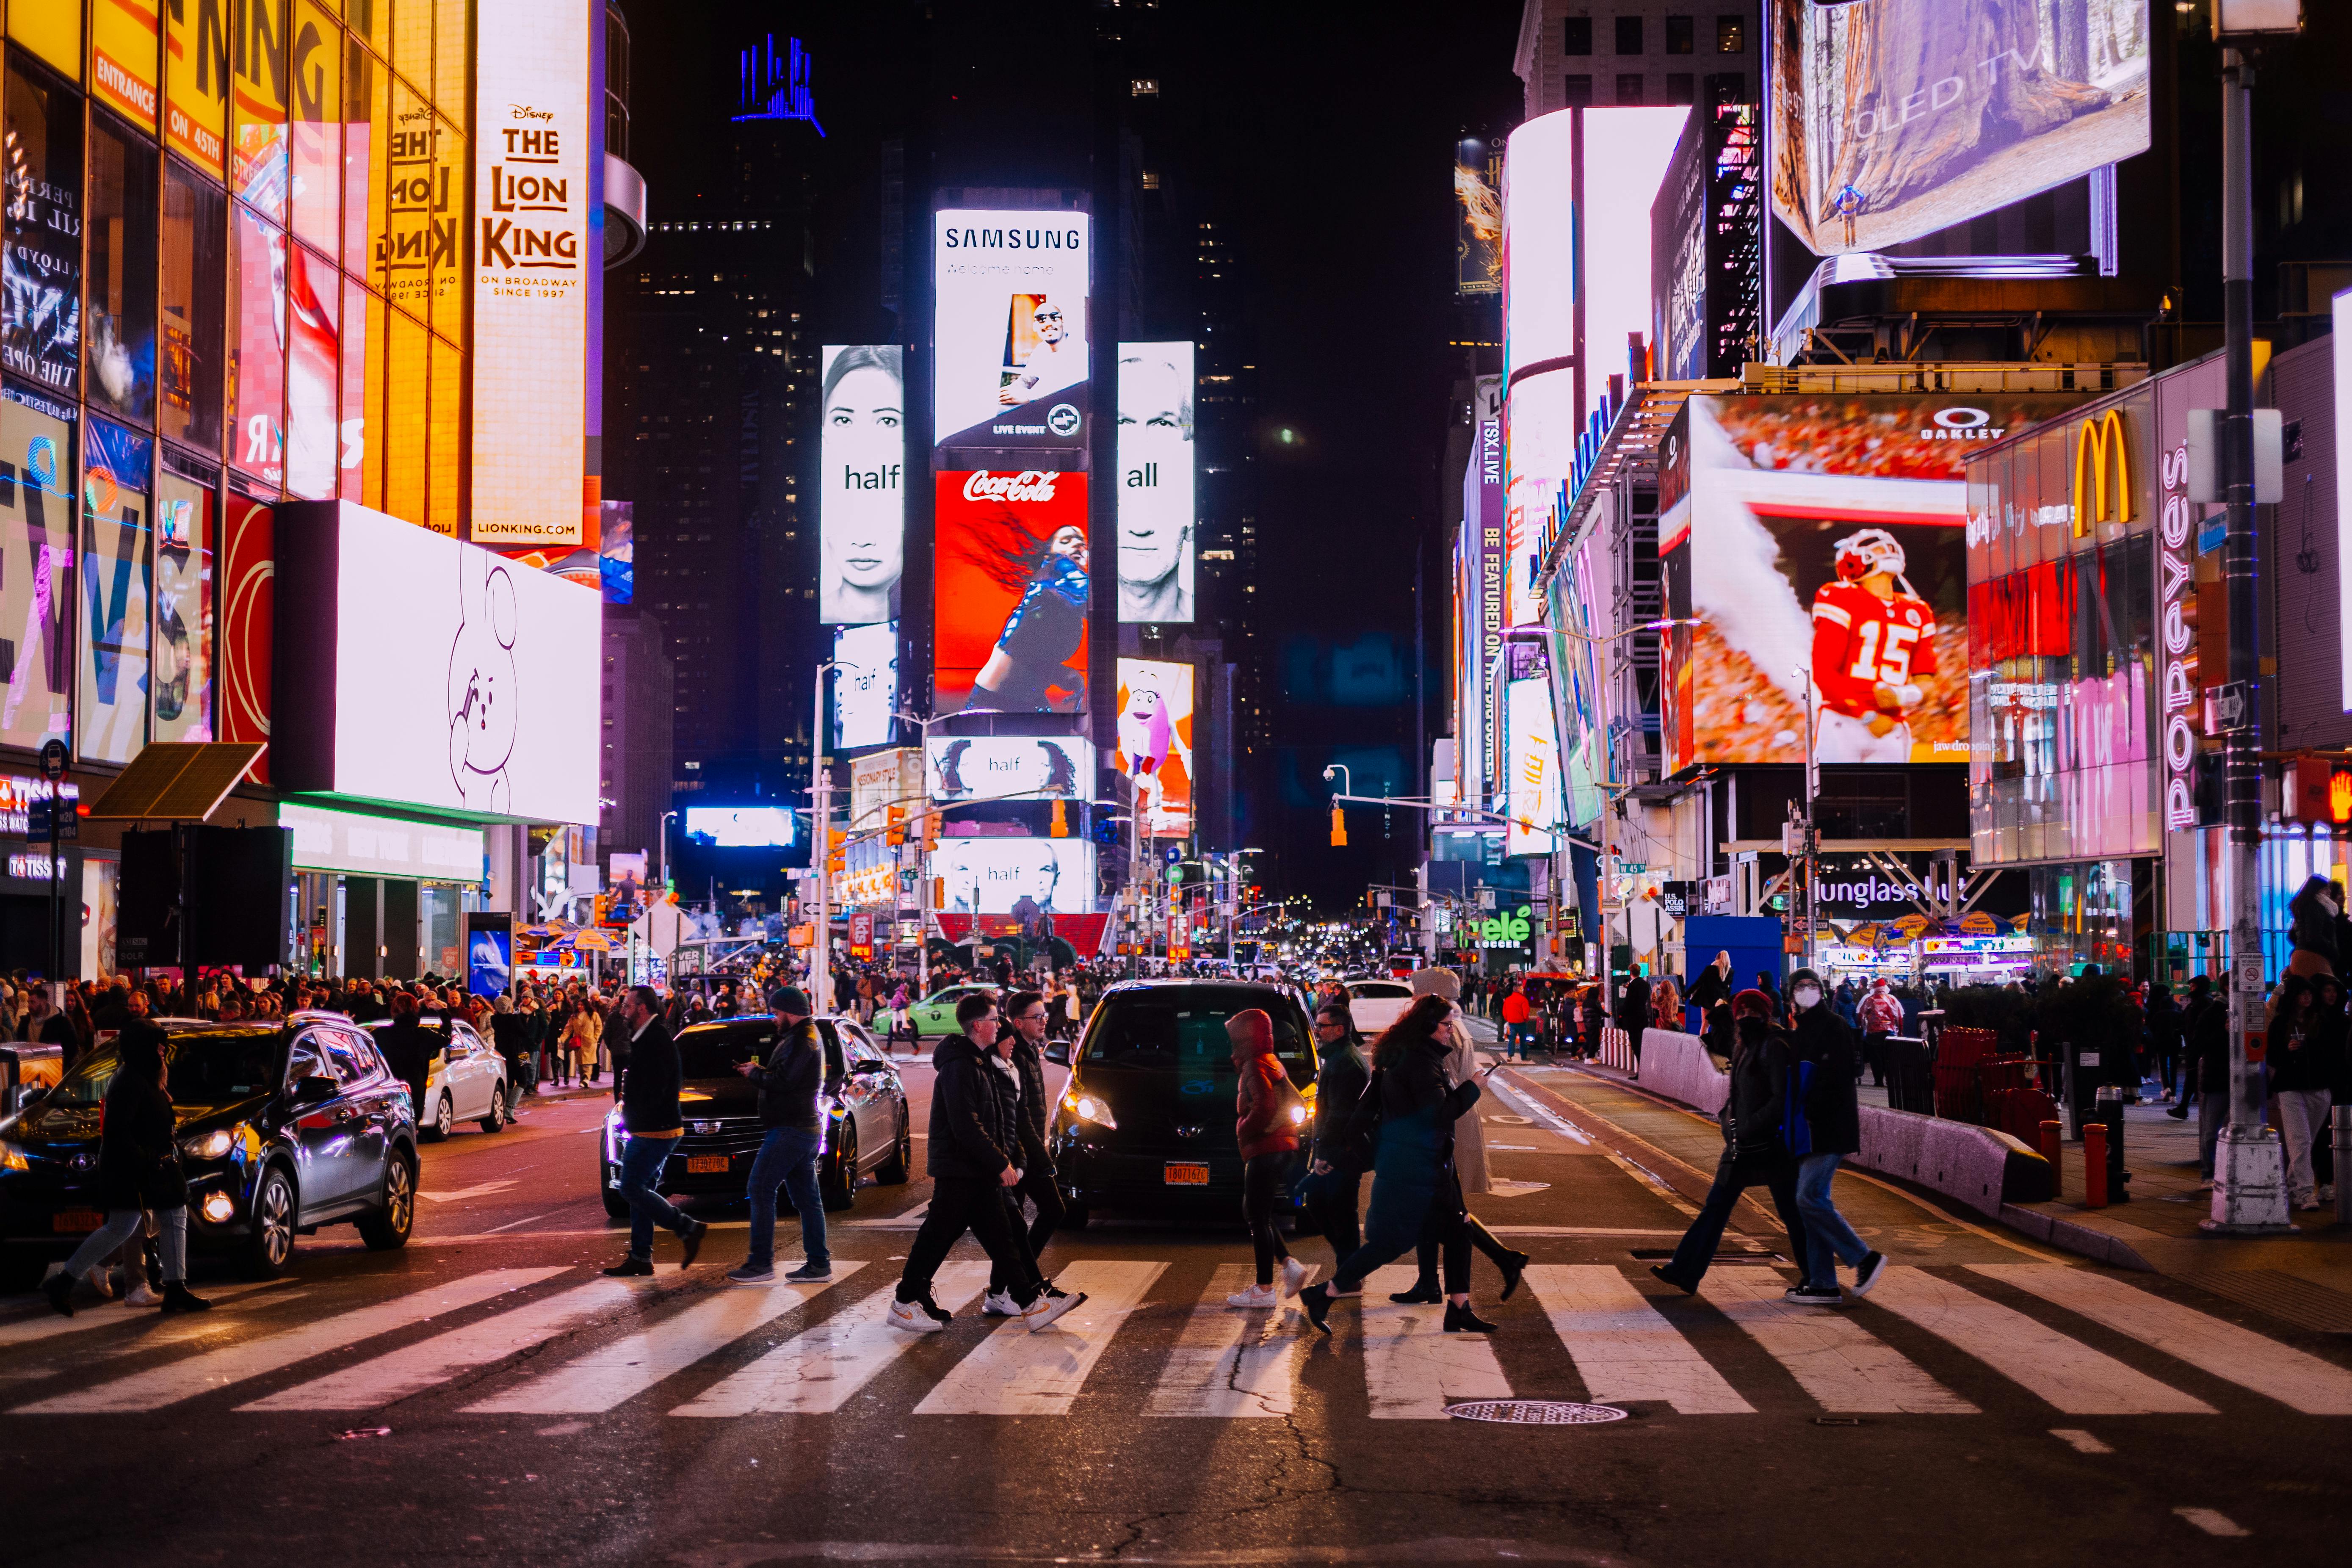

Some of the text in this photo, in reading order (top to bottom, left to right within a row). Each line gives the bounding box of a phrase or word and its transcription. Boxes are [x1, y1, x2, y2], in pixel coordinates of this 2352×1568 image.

[97, 55, 154, 115] ENTRANCE
[1856, 76, 1963, 138] OLED
[1978, 36, 2041, 86] TV
[508, 104, 553, 124] Disney
[171, 110, 188, 138] ON
[194, 130, 220, 161] 45TH
[503, 129, 559, 155] THE
[1484, 156, 1503, 186] H
[491, 166, 567, 212] LION
[481, 218, 576, 269] KING
[946, 228, 1079, 249] SAMSUNG
[1014, 264, 1053, 275] home
[481, 276, 577, 288] ON BROADWAY
[494, 288, 564, 298] SINCE 1997
[994, 425, 1046, 434] LIVE EVENT
[1921, 429, 2005, 440] OAKLEY
[1484, 419, 1500, 485] TSX.LIVE
[845, 464, 901, 489] half
[1127, 462, 1158, 487] all
[478, 524, 575, 535] LIONKING.COM
[1484, 527, 1500, 548] BE
[1484, 553, 1500, 632] FEATURED
[1484, 634, 1500, 657] ON
[1850, 619, 1920, 687] 15
[854, 668, 876, 692] half
[1934, 740, 1948, 754] jaw
[989, 757, 1020, 772] half
[26, 859, 66, 879] TISST
[988, 867, 1020, 880] half
[1630, 865, 1638, 873] 45
[1924, 876, 1968, 902] hut
[854, 916, 869, 944] tkts
[120, 952, 144, 960] SOLR
[672, 951, 699, 961] VER
[1169, 1167, 1205, 1180] T807167C
